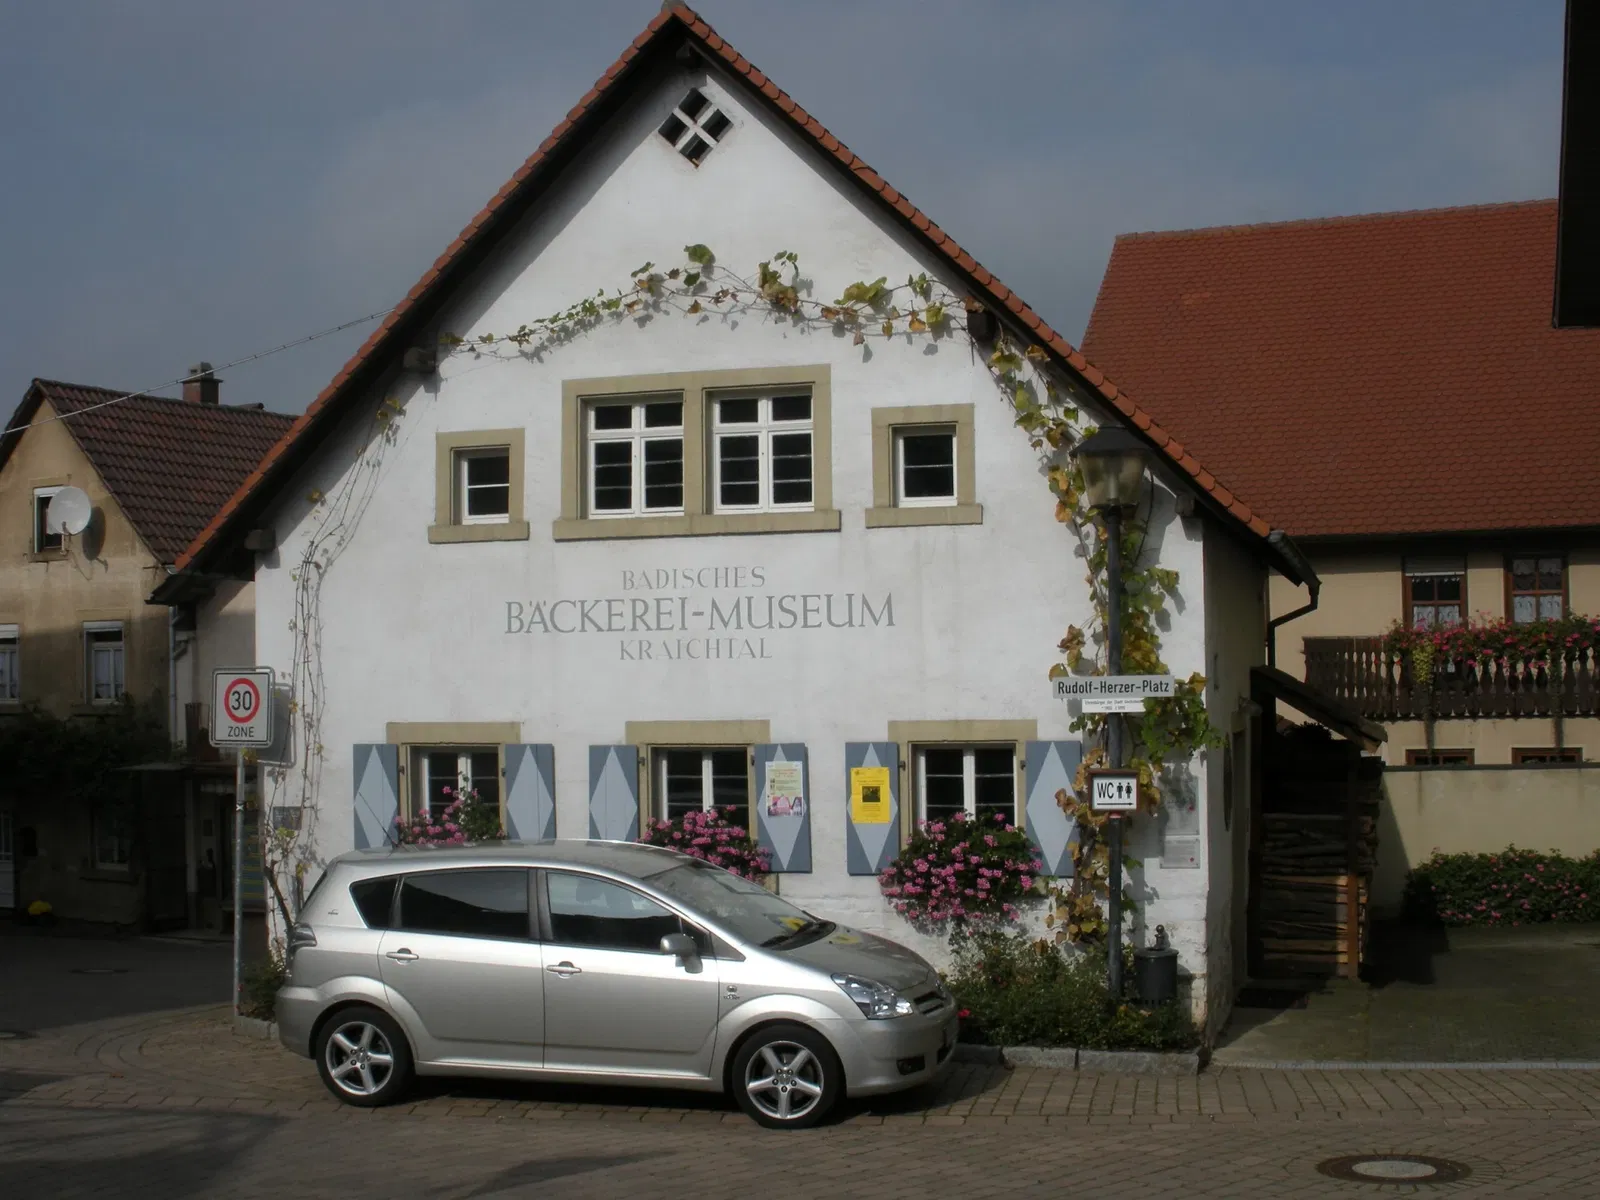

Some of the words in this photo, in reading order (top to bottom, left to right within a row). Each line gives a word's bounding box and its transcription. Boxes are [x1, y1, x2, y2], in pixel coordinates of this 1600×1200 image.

[622, 567, 766, 591] BADISCHES
[505, 593, 895, 634] BÄCKEREI-MUSEUM
[619, 638, 773, 661] KRAICHTAL
[1058, 680, 1170, 694] Rudolf-Herzer-Platz
[231, 690, 252, 711] 30
[228, 726, 254, 738] ZONE
[1097, 782, 1114, 799] WC
